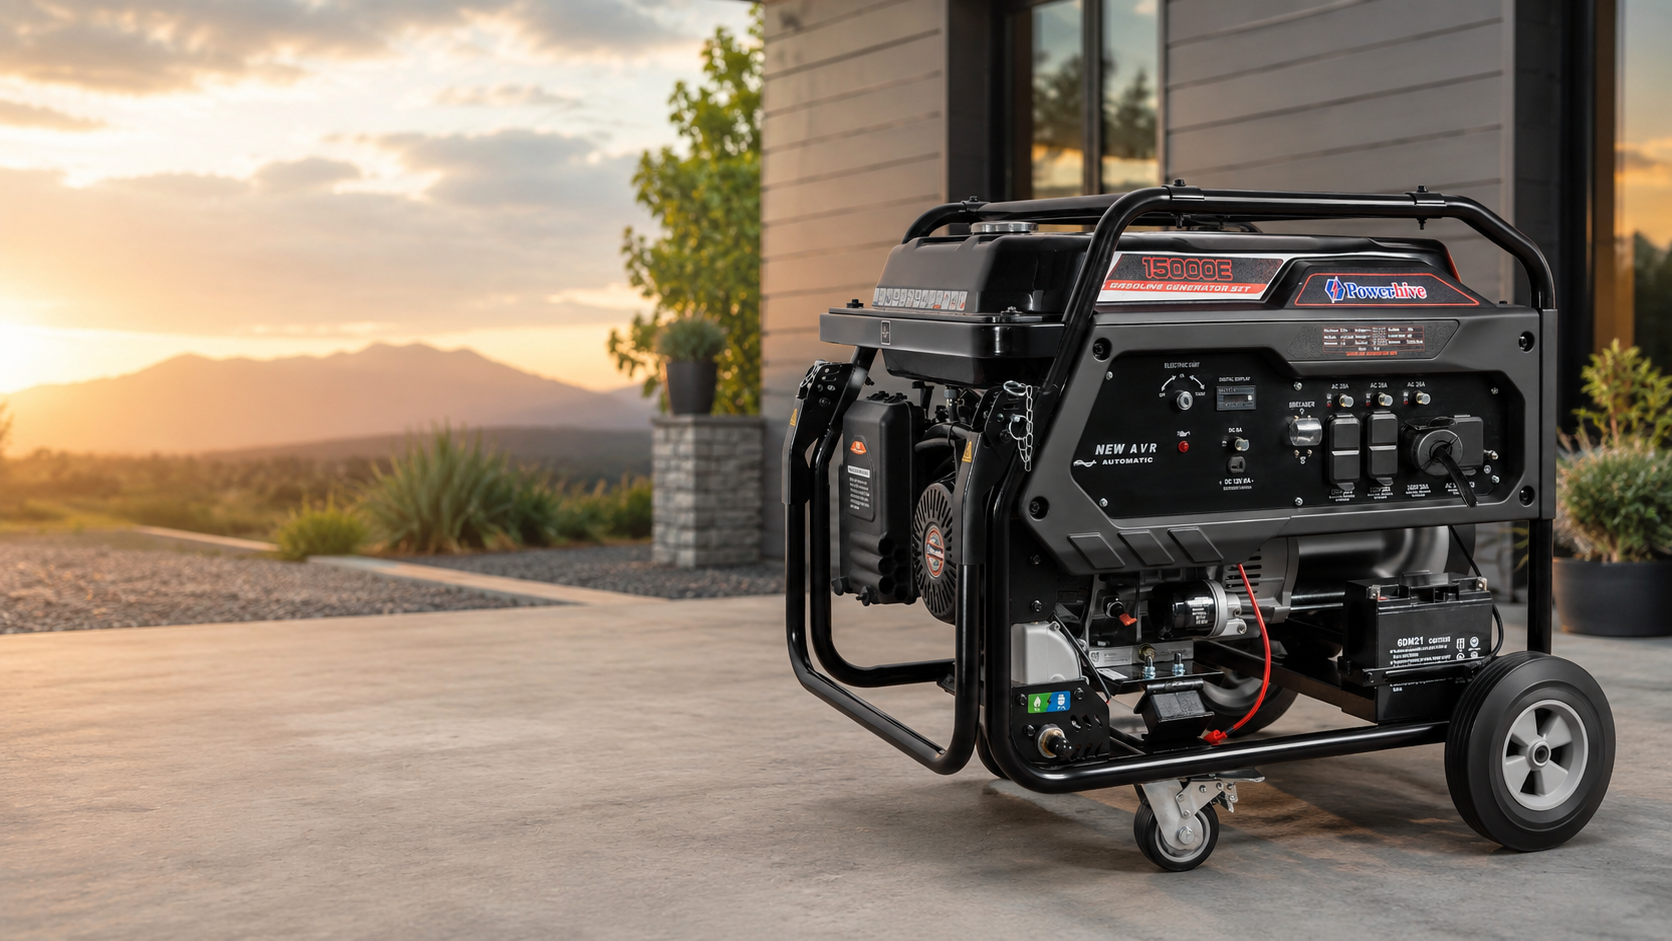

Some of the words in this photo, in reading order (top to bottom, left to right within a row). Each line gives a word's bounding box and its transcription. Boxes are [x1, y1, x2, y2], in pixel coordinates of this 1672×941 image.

[1142, 257, 1233, 280] 15000E
[1109, 282, 1163, 290] GASOLINE
[1166, 284, 1228, 292] GENERATOR
[1345, 282, 1427, 299] Powerhive
[1095, 443, 1126, 455] NEW
[1102, 457, 1154, 466] AUTOMATIC
